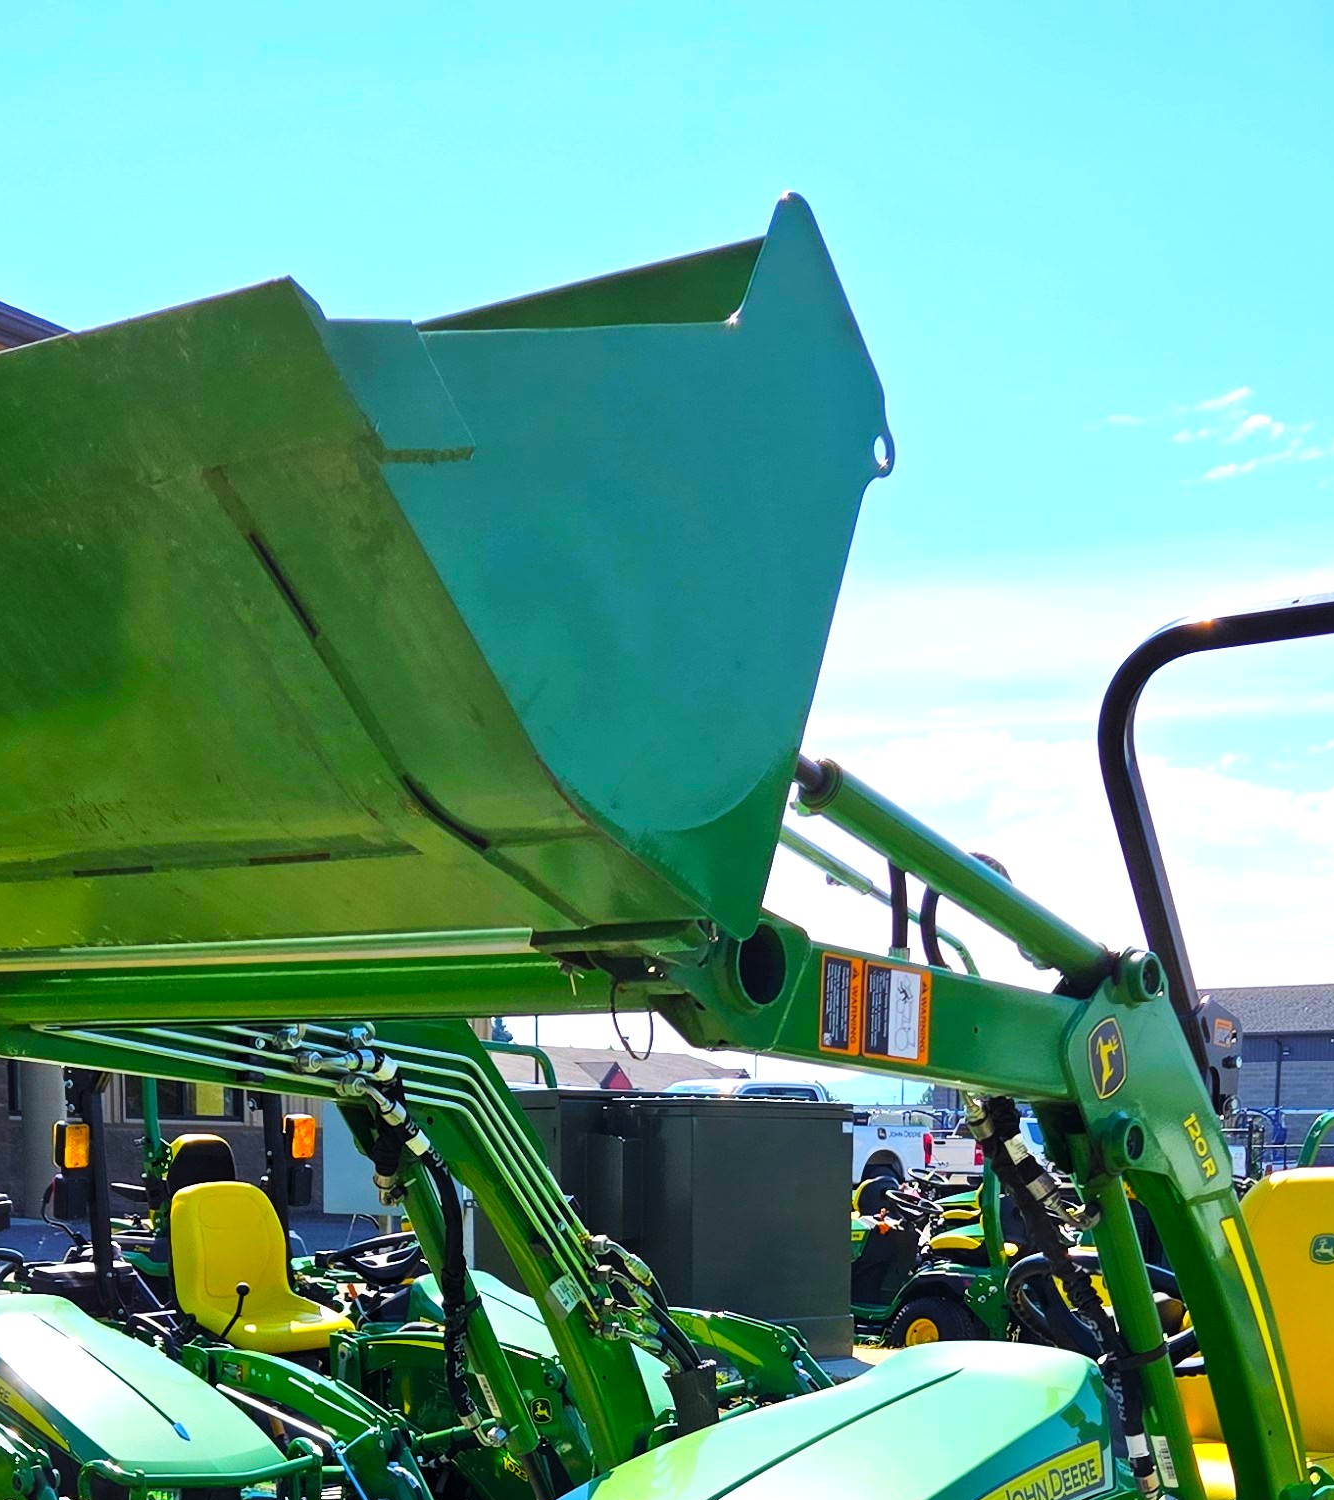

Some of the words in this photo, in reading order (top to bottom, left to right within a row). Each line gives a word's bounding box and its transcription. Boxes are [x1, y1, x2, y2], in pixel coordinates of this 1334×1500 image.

[850, 985, 859, 1044] WARNING
[918, 998, 928, 1053] WARNING
[1048, 1458, 1098, 1500] DEERE
